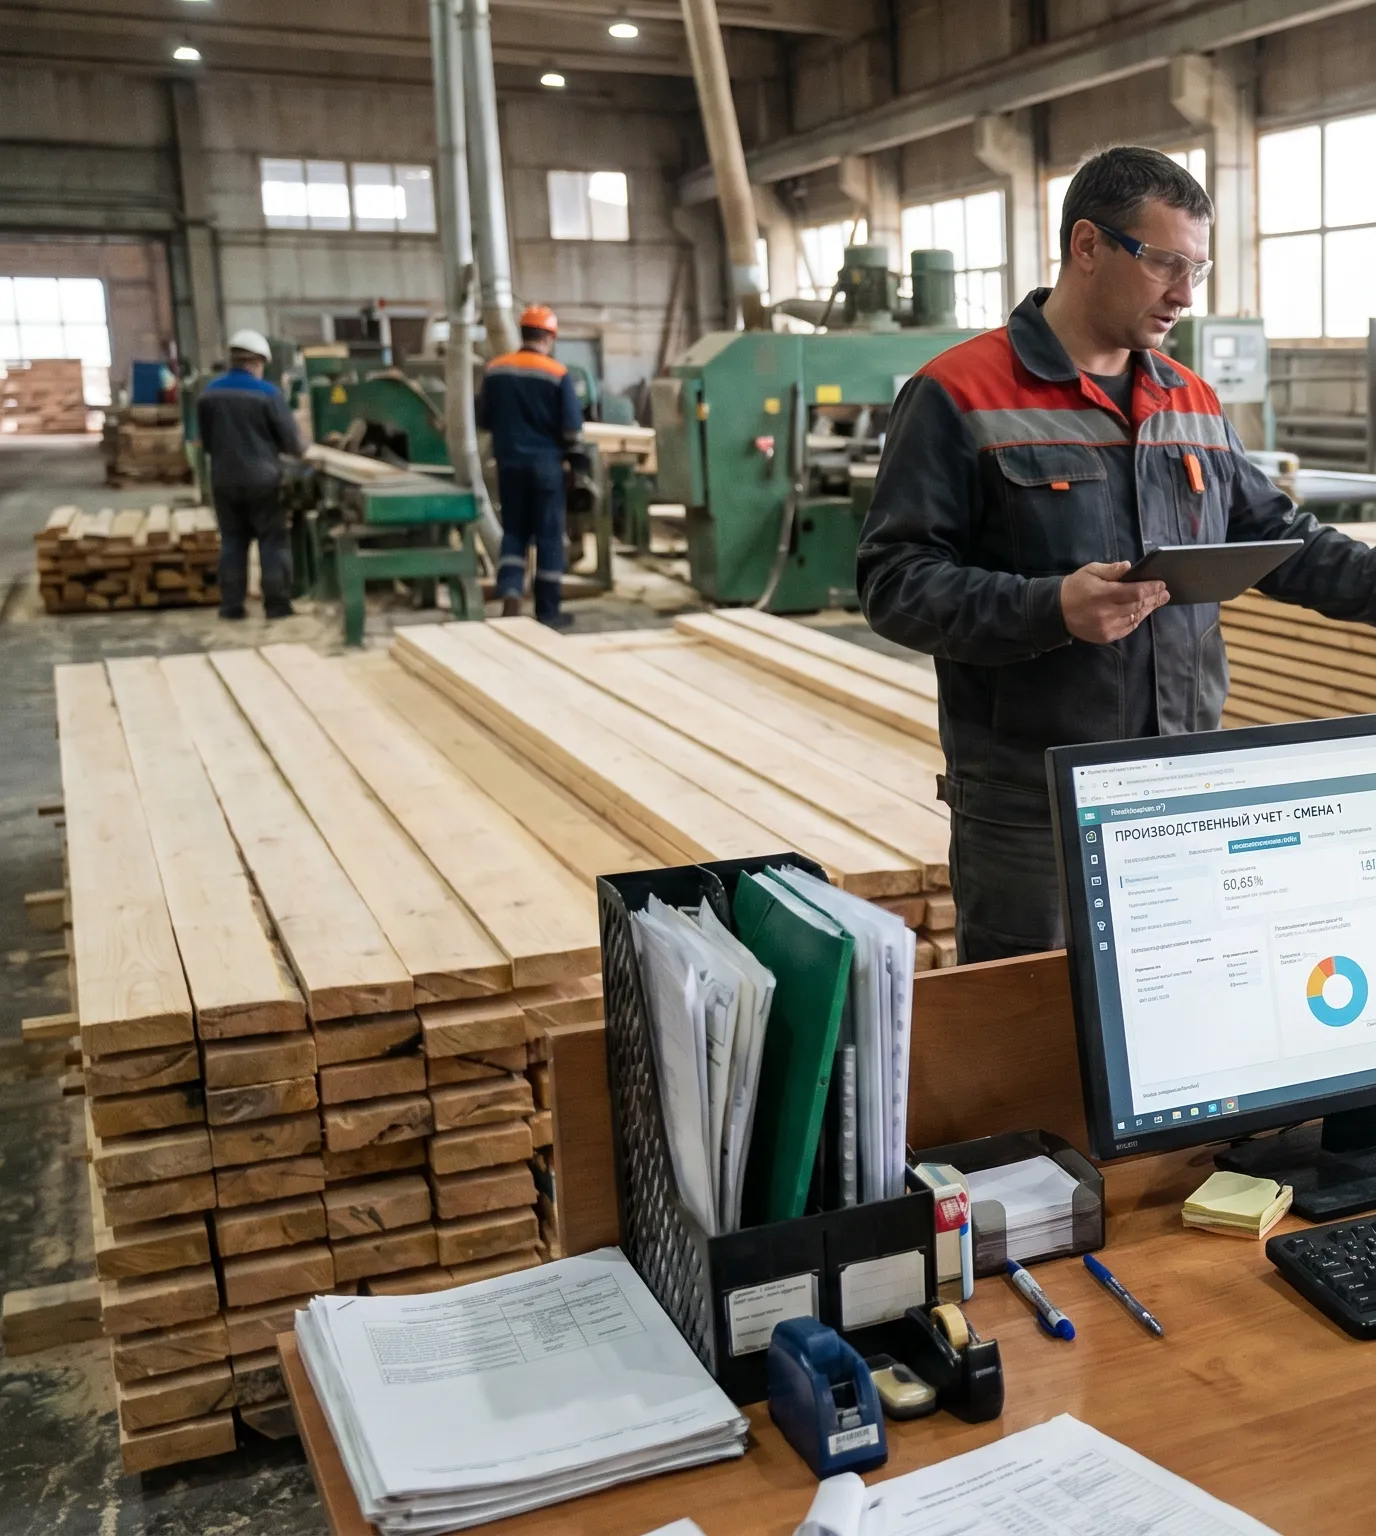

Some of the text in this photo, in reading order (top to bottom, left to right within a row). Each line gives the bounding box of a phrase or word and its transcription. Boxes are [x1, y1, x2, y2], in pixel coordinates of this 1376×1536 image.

[1115, 812, 1250, 843] ПРОИЗВОДСТВЕННЫЙ
[1253, 810, 1283, 825] УЧЕТ
[1293, 804, 1334, 819] СМЕНА
[1336, 803, 1342, 814] 1
[1223, 875, 1264, 891] 60,65%
